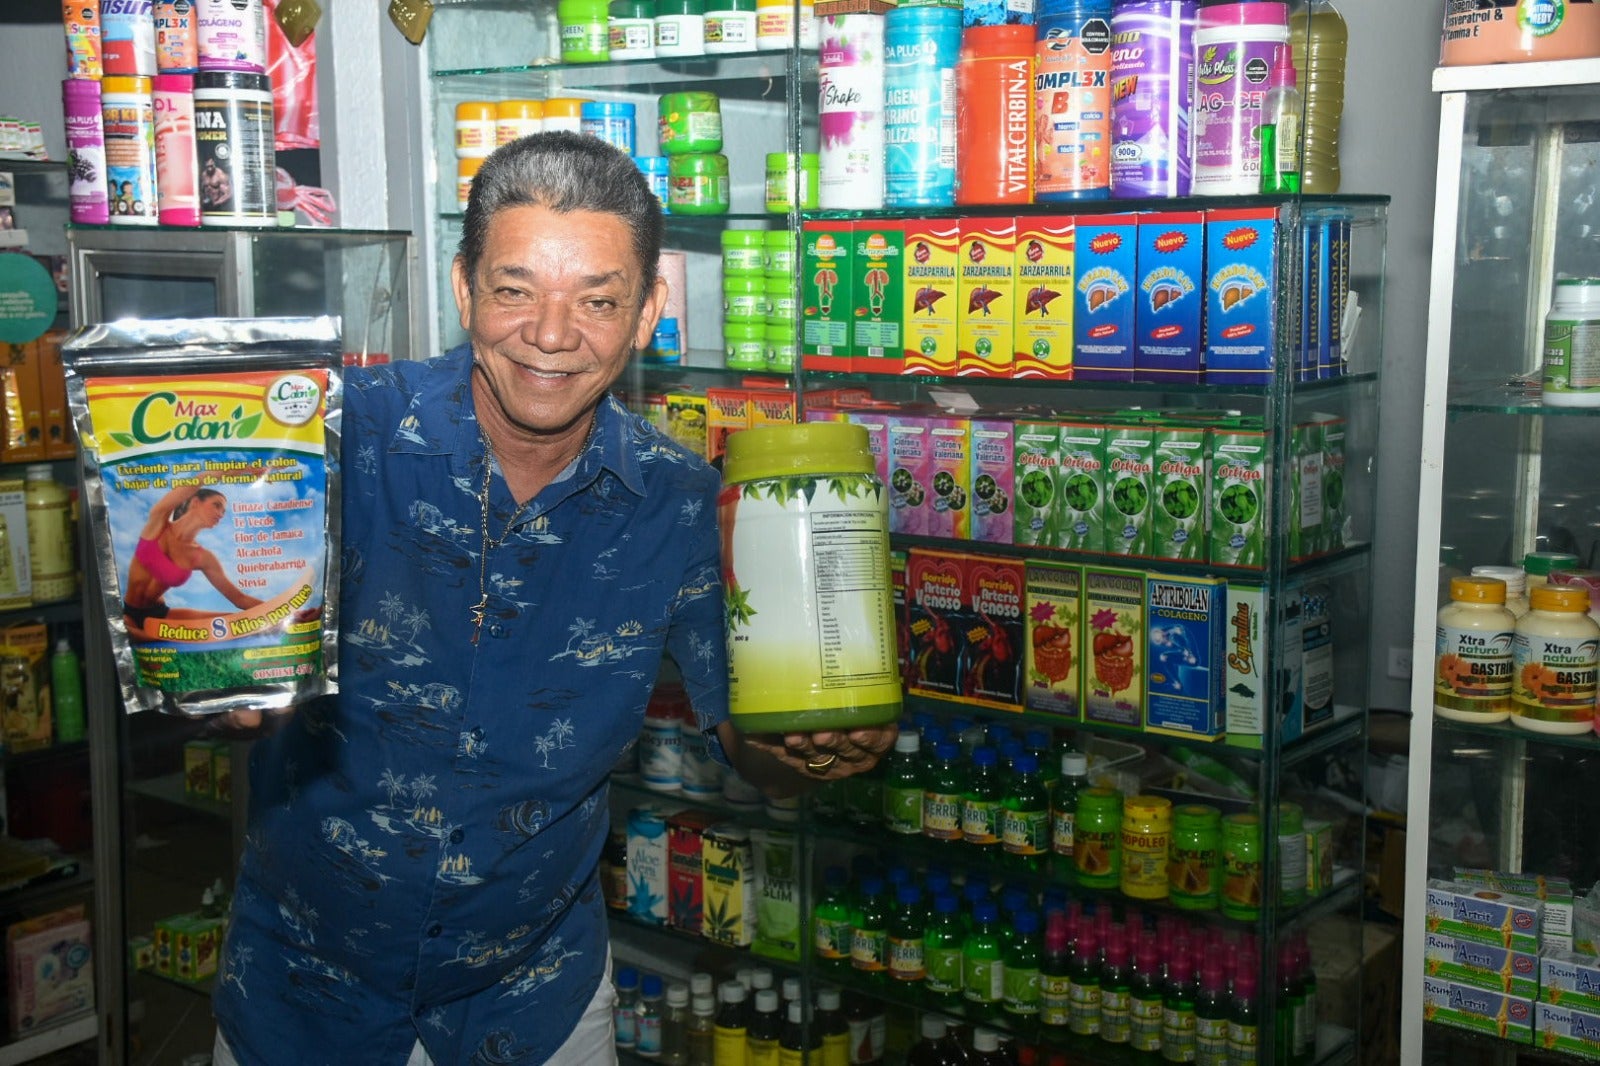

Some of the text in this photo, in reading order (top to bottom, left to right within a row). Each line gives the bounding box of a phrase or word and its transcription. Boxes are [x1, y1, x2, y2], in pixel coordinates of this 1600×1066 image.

[1494, 8, 1503, 21] &
[1483, 26, 1491, 37] E
[896, 45, 921, 58] PLUS
[825, 84, 862, 106] Shake
[1113, 75, 1139, 102] NEW
[1052, 92, 1071, 117] B
[1195, 91, 1266, 112] AG-CE
[1008, 60, 1027, 193] VITALCERBIN-A
[1118, 150, 1137, 161] 900g
[1093, 237, 1119, 249] Nuevo
[1157, 236, 1184, 248] Nuevo
[1226, 232, 1254, 245] Nuevo
[908, 266, 955, 278] ZARZAPARRILA
[962, 266, 1012, 278] ZARZAPARRILA
[1019, 265, 1071, 277] ZARZAPARRILA
[174, 401, 218, 417] Max
[719, 407, 747, 418] VIDA
[763, 409, 792, 420] VIDA
[131, 391, 231, 444] Colon
[116, 456, 297, 477] Excelente para limpiar el colon
[1019, 452, 1056, 467] Ortiga
[1063, 456, 1101, 471] Ortiga
[1111, 458, 1150, 474] Ortiga
[1160, 461, 1200, 476] Ortiga
[1218, 464, 1261, 481] Ortiga
[123, 478, 151, 491] bajar
[153, 476, 168, 488] de
[171, 475, 200, 489] peso
[202, 474, 218, 485] de
[221, 472, 257, 485] forma
[232, 497, 314, 513] Linaza Canadiense
[248, 515, 275, 528] Verde
[234, 531, 254, 544] Flor
[257, 531, 268, 541] de
[236, 547, 282, 559] Alcachofa
[237, 559, 307, 574] Quiebrabarriga
[238, 577, 267, 589] Stevia
[924, 581, 961, 597] Arterio
[914, 587, 962, 611] Venoso
[981, 588, 1020, 604] Arterio
[1151, 583, 1209, 611] ARTRIBOLAN
[158, 583, 313, 640] Reduce 8 Kilos por mes
[970, 594, 1021, 618] Venoso
[1157, 608, 1208, 622] COLAGENO
[1459, 634, 1486, 646] Xtra
[1458, 645, 1499, 655] natura
[1544, 642, 1572, 654] Xtra
[1542, 652, 1585, 663] natura
[762, 887, 793, 903] SLIM
[1458, 901, 1492, 922] Artrit
[1458, 944, 1491, 966] Artrit
[1454, 990, 1488, 1011] Artrit
